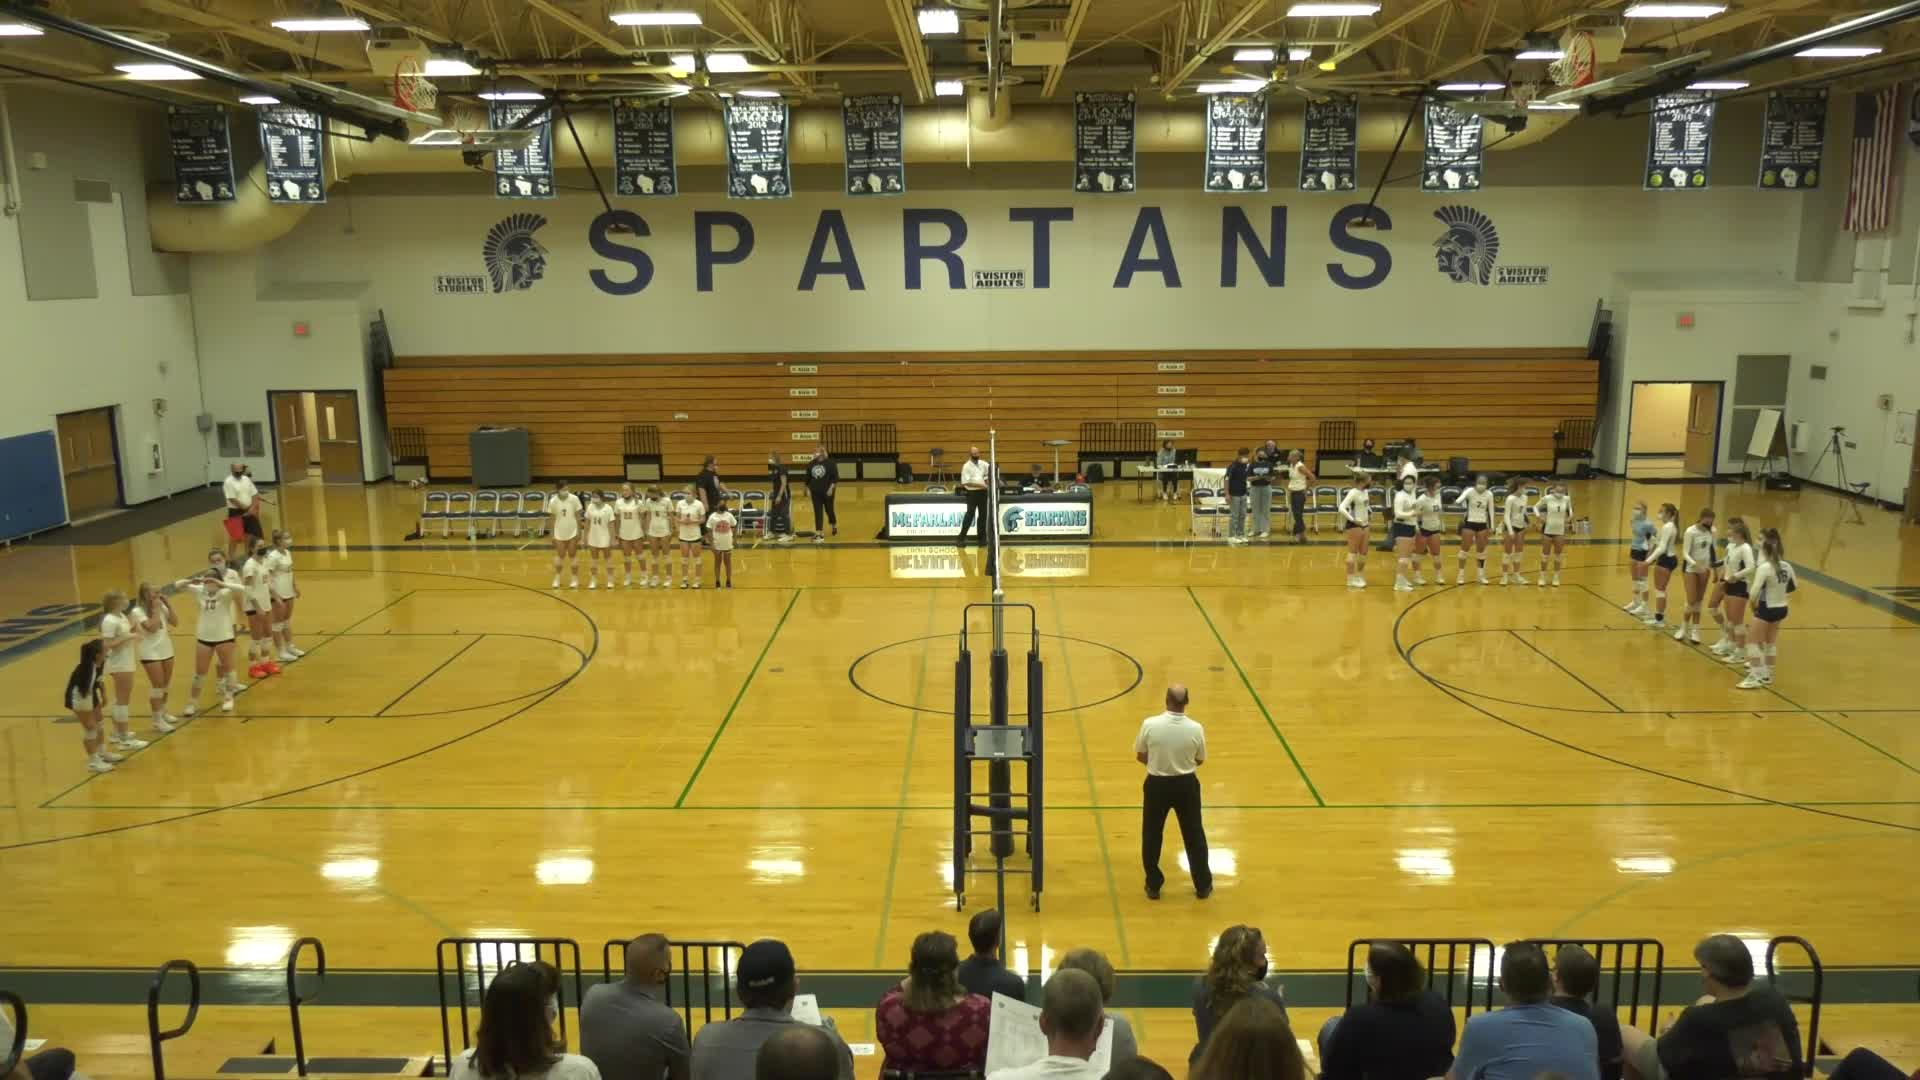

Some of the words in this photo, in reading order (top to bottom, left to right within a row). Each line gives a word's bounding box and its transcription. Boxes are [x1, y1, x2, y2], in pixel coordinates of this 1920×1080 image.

[588, 202, 1393, 295] SPARTANS
[983, 271, 1024, 279] VISITOR
[1025, 510, 1087, 526] SPARTANS
